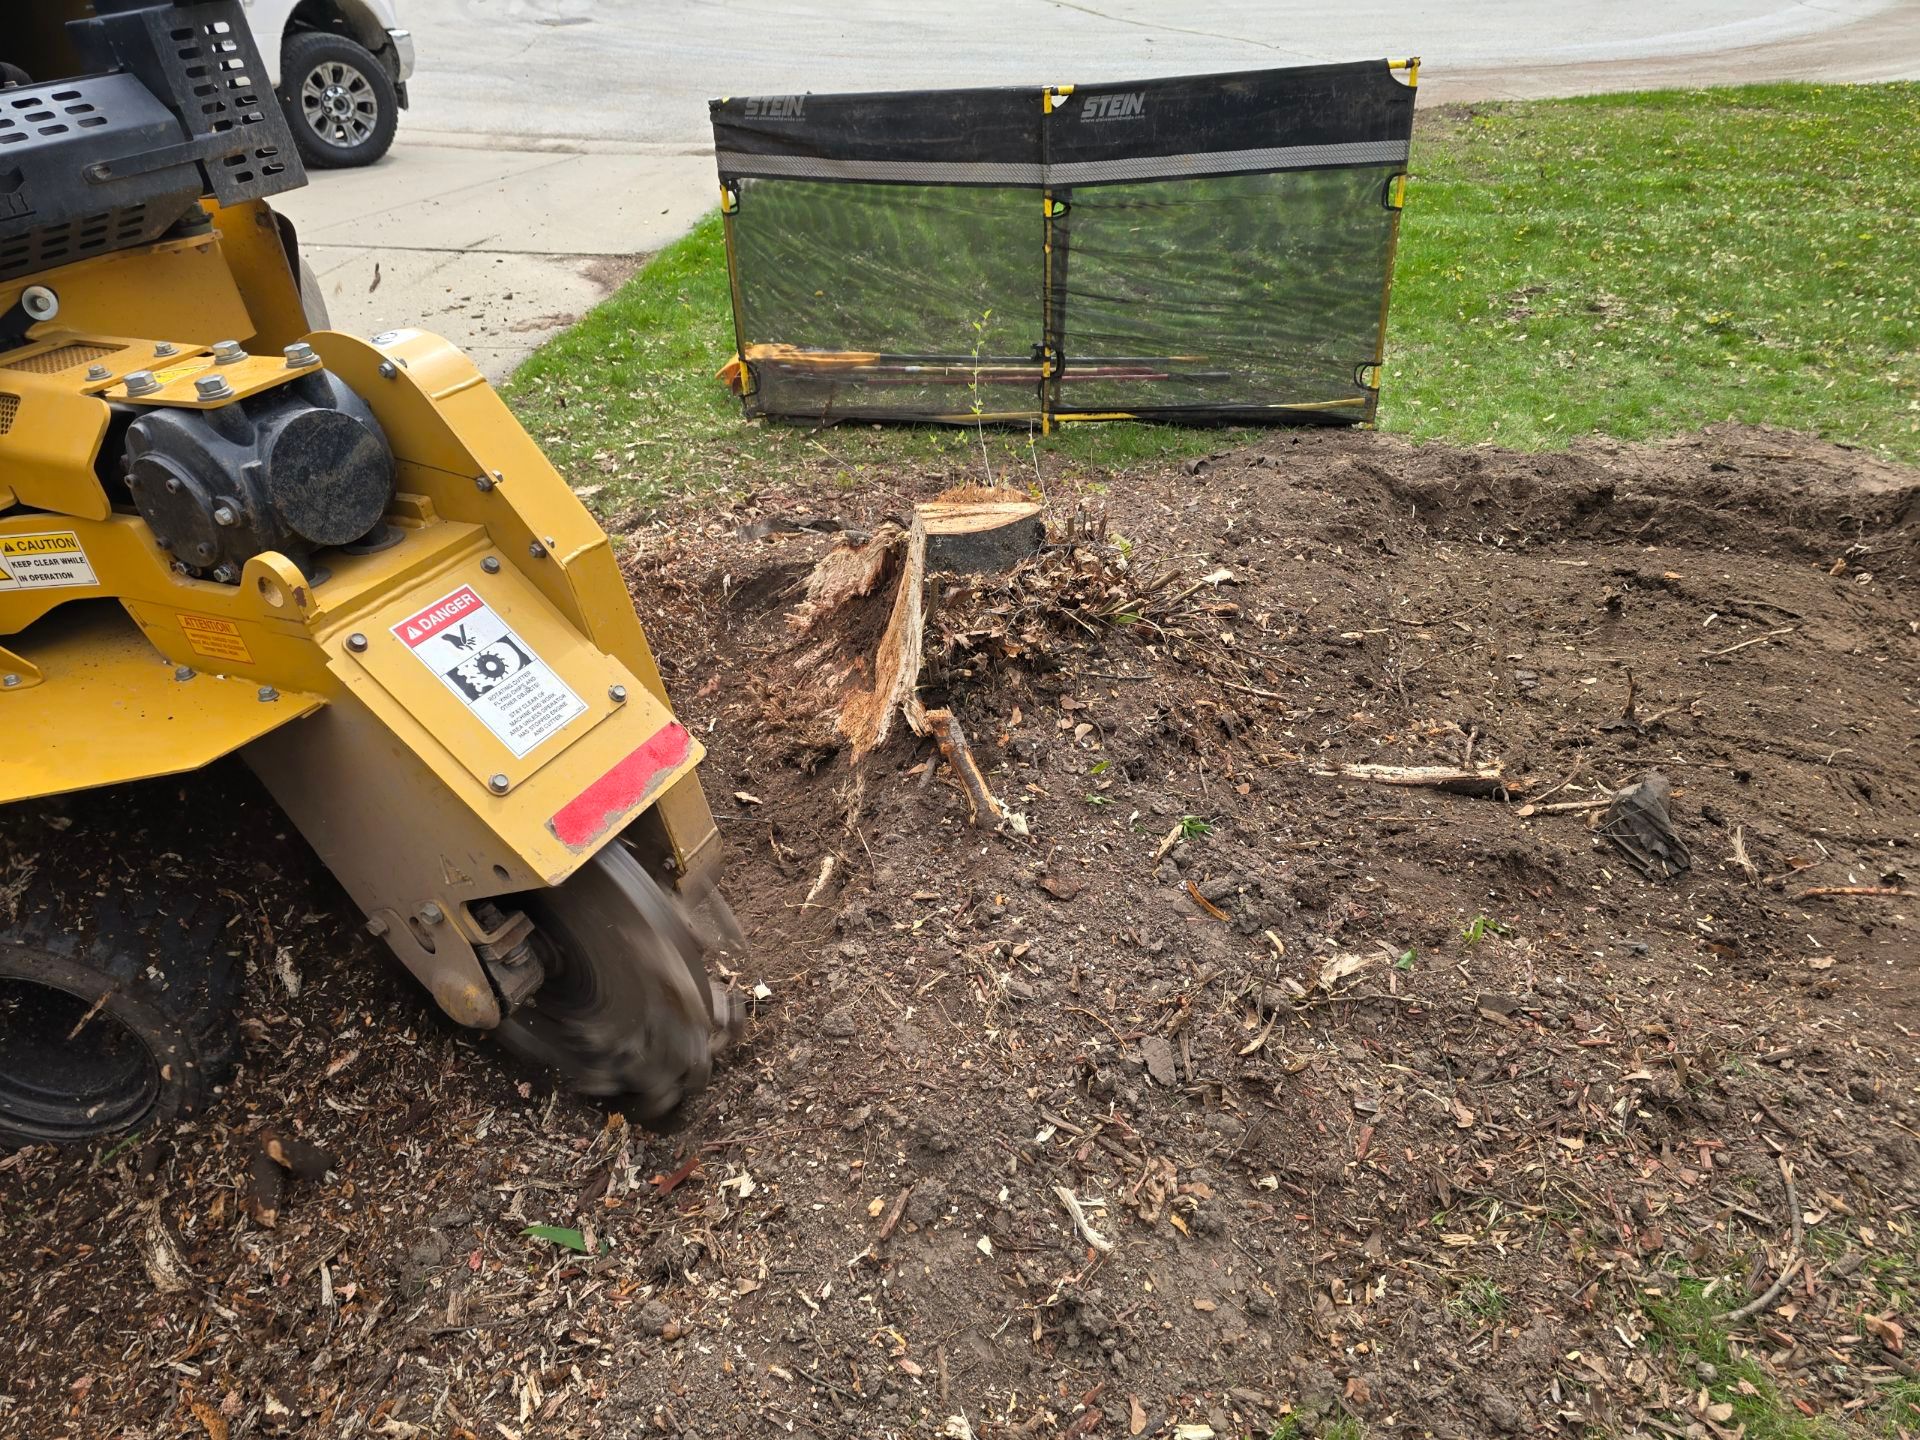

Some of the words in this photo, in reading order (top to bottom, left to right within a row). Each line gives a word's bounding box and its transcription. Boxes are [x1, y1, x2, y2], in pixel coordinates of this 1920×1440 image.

[744, 95, 805, 116] STEIN
[1081, 92, 1145, 118] STEIN
[17, 537, 77, 551] CAUTION
[11, 560, 32, 568] KEEP
[34, 558, 59, 567] CLEAR
[60, 556, 85, 565] WHILE
[18, 574, 28, 582] IN
[29, 572, 74, 582] OPERATION
[418, 593, 475, 630] DANGER
[488, 683, 513, 702] ROTATING
[493, 693, 512, 706] FLYING
[510, 683, 526, 695] CHIPS
[524, 676, 536, 685] AND
[500, 698, 517, 711] OTHER
[508, 708, 522, 718] STAY
[521, 696, 538, 709] CLEAR
[508, 725, 523, 735] AREA
[522, 712, 541, 726] UNLESS
[540, 694, 566, 713] OPERATOR
[509, 710, 531, 726] MACHINE
[530, 703, 542, 711] AND
[540, 693, 556, 704] WORK
[518, 729, 529, 738] HAS
[528, 714, 550, 730] STOPPED
[549, 702, 568, 715] ENGINE
[532, 727, 544, 736] AND
